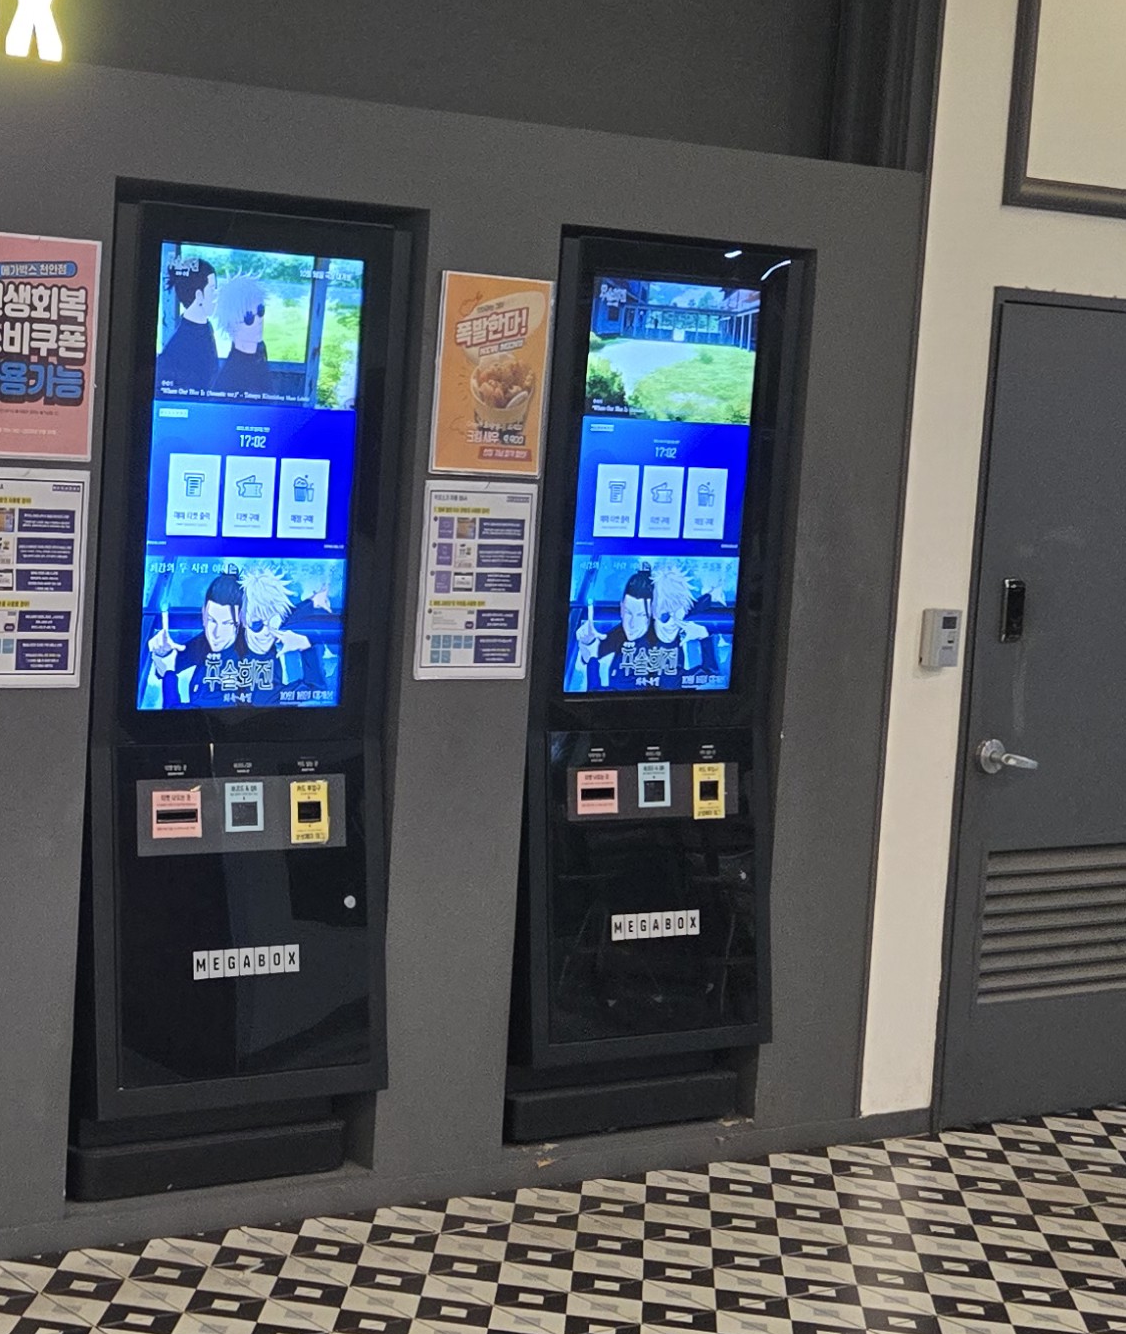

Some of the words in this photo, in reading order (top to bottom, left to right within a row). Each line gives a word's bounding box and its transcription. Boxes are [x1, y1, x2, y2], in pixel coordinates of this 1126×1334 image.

[39, 264, 67, 275] 천안점
[239, 434, 267, 449] 17:02
[202, 658, 275, 692] 주술회전
[613, 915, 698, 935] MEGABOX
[195, 950, 297, 973] MEGABOX
